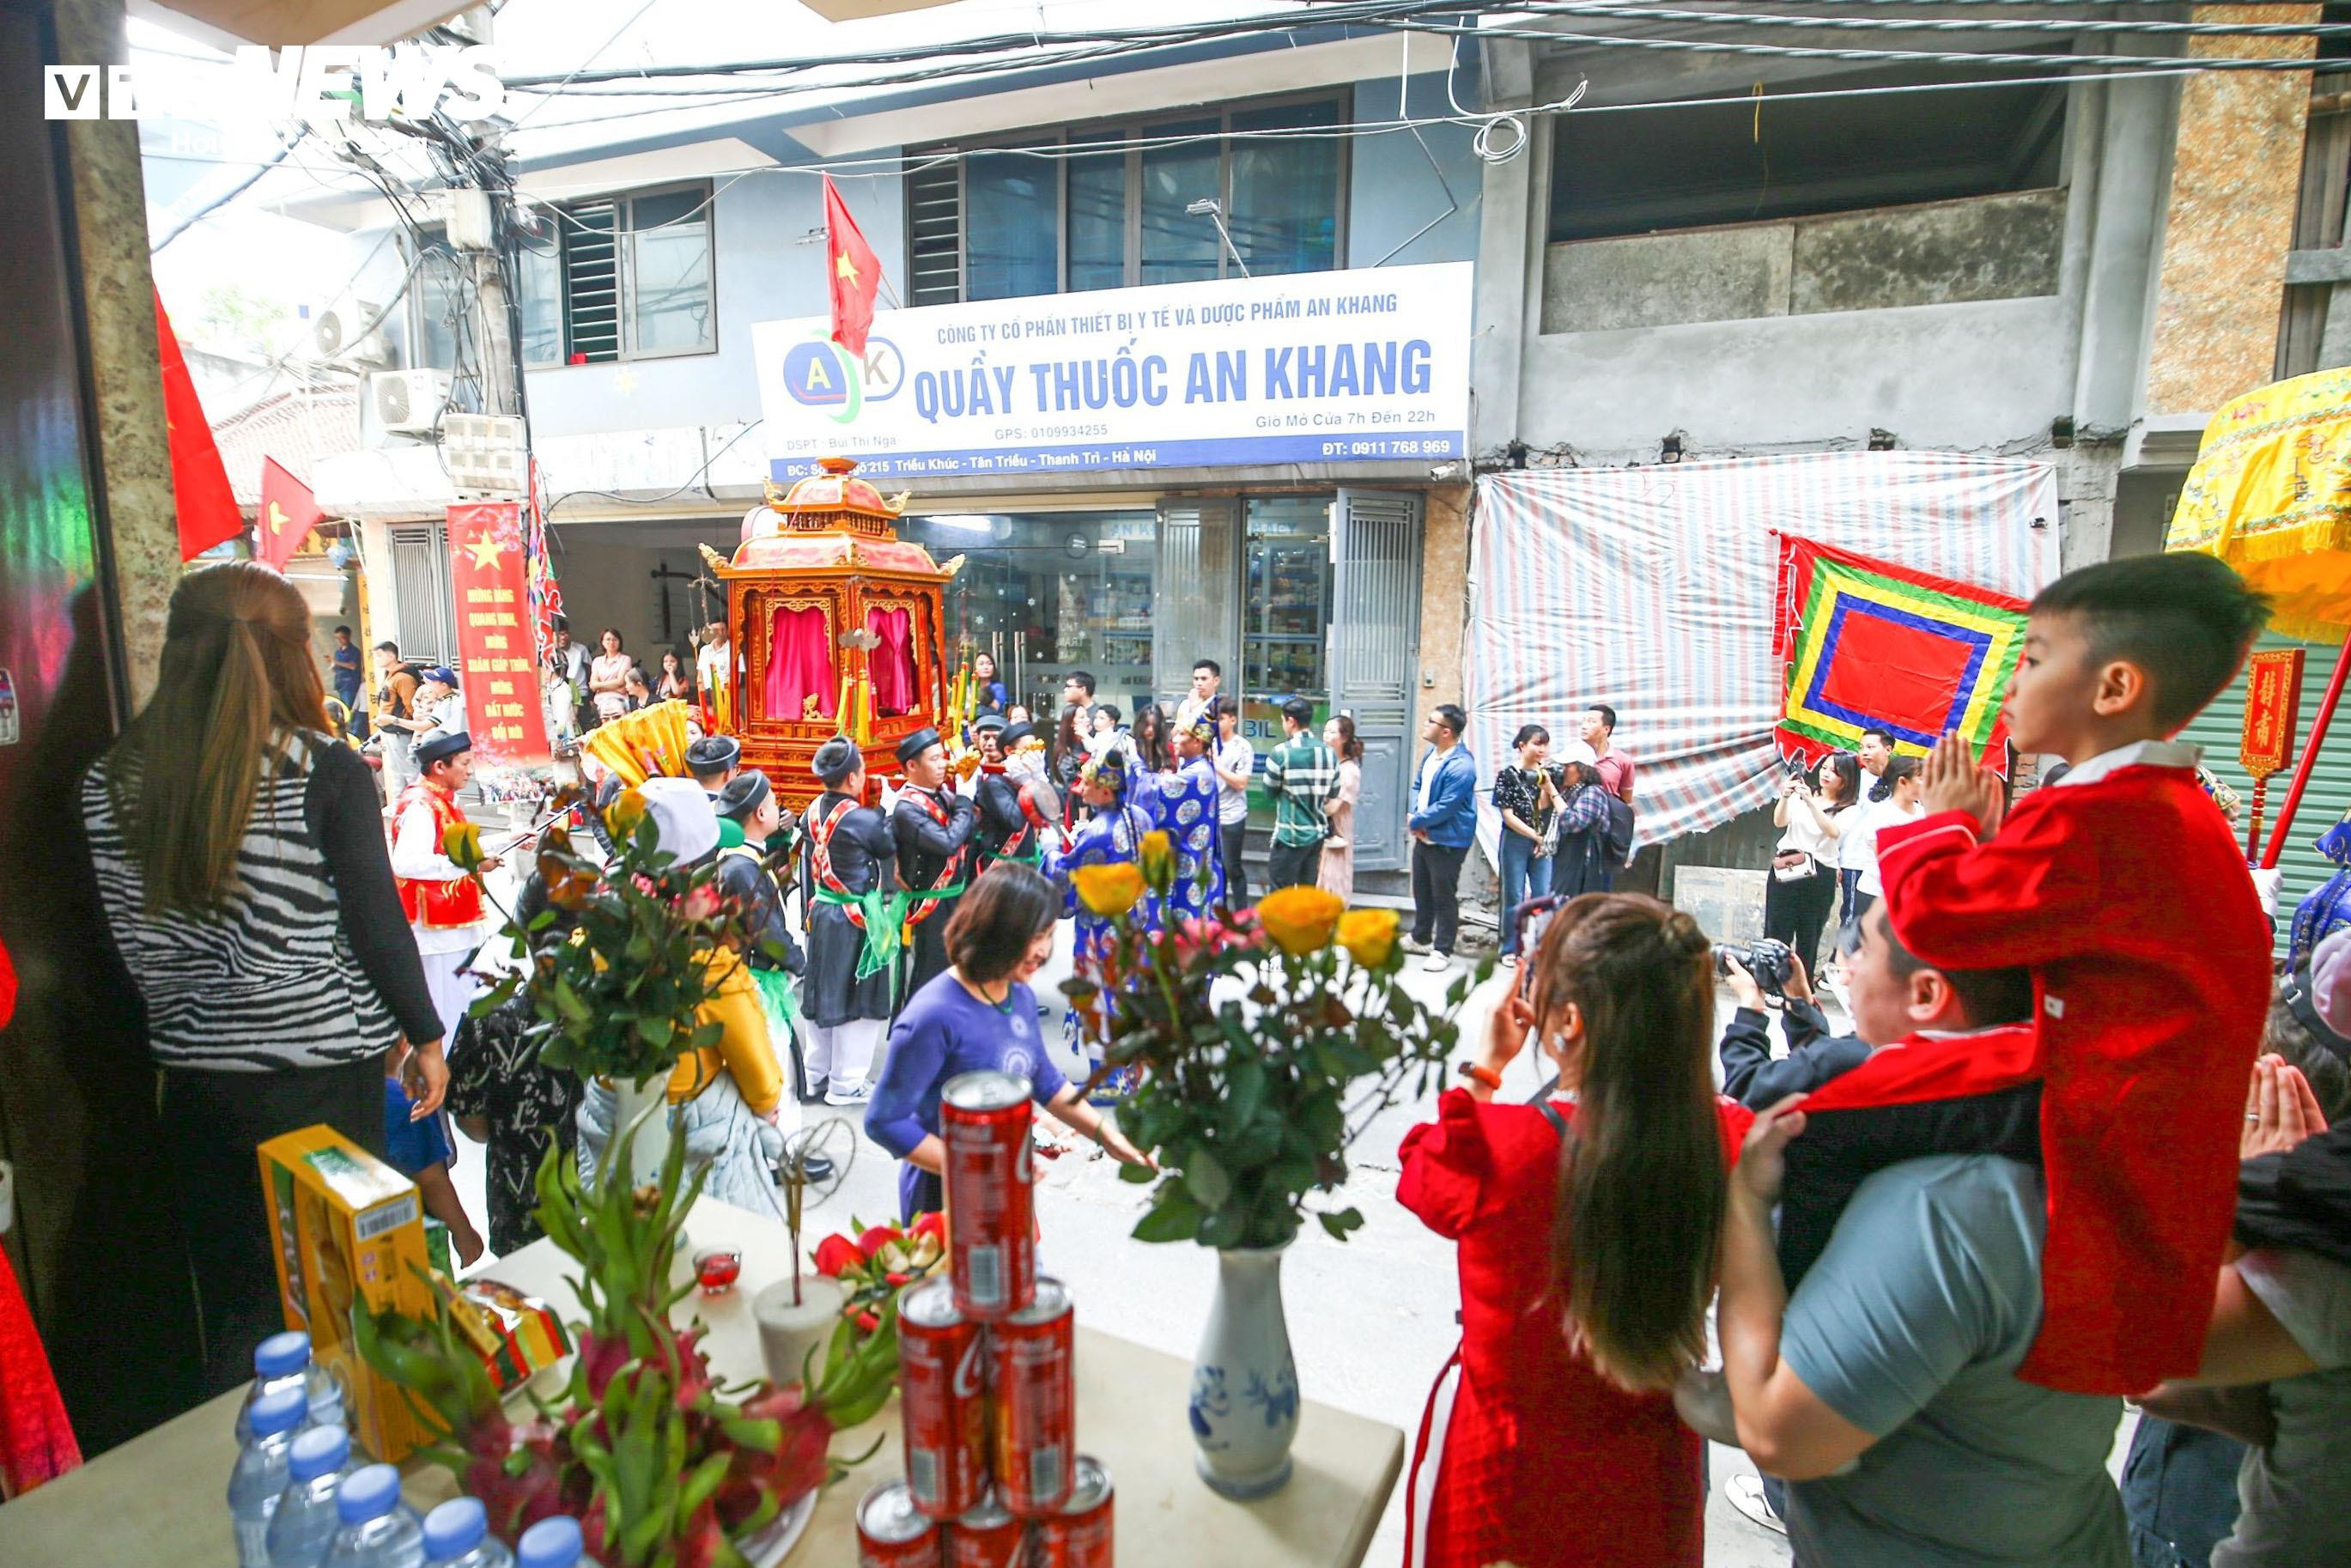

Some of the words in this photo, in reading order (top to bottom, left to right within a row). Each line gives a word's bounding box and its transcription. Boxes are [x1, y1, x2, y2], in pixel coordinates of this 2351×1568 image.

[938, 323, 976, 344] CÔNG
[980, 324, 996, 342] TY
[1071, 310, 1113, 334] THIẾT
[1117, 313, 1133, 334] BỊ
[1138, 312, 1147, 329] Y
[1151, 304, 1170, 327] TẾ
[1176, 304, 1196, 325] VÀ
[1201, 302, 1245, 326] DƯỢC
[1251, 294, 1301, 321] PHẨM
[1306, 298, 1331, 317] AN
[1337, 294, 1398, 315] KHANG
[805, 357, 832, 391] A
[864, 350, 890, 386] K
[914, 349, 1015, 423] QUẦY
[1030, 337, 1168, 412] THUỐC
[1185, 349, 1247, 404] AN
[1265, 339, 1431, 399] KHANG
[1347, 411, 1365, 424] 7h
[1371, 409, 1401, 424] Đến
[1407, 410, 1436, 422] 22h
[1031, 424, 1108, 439] 0109934255
[869, 459, 890, 472] 215
[928, 456, 959, 471] Khúc
[969, 455, 993, 469] Tân
[1038, 452, 1079, 466] Thanh
[1112, 447, 1131, 464] Hà
[1133, 449, 1157, 464] Nội
[1322, 441, 1347, 455] ĐT:
[1351, 441, 1386, 454] 0911
[1391, 441, 1418, 453] 768
[1422, 440, 1450, 453] 969
